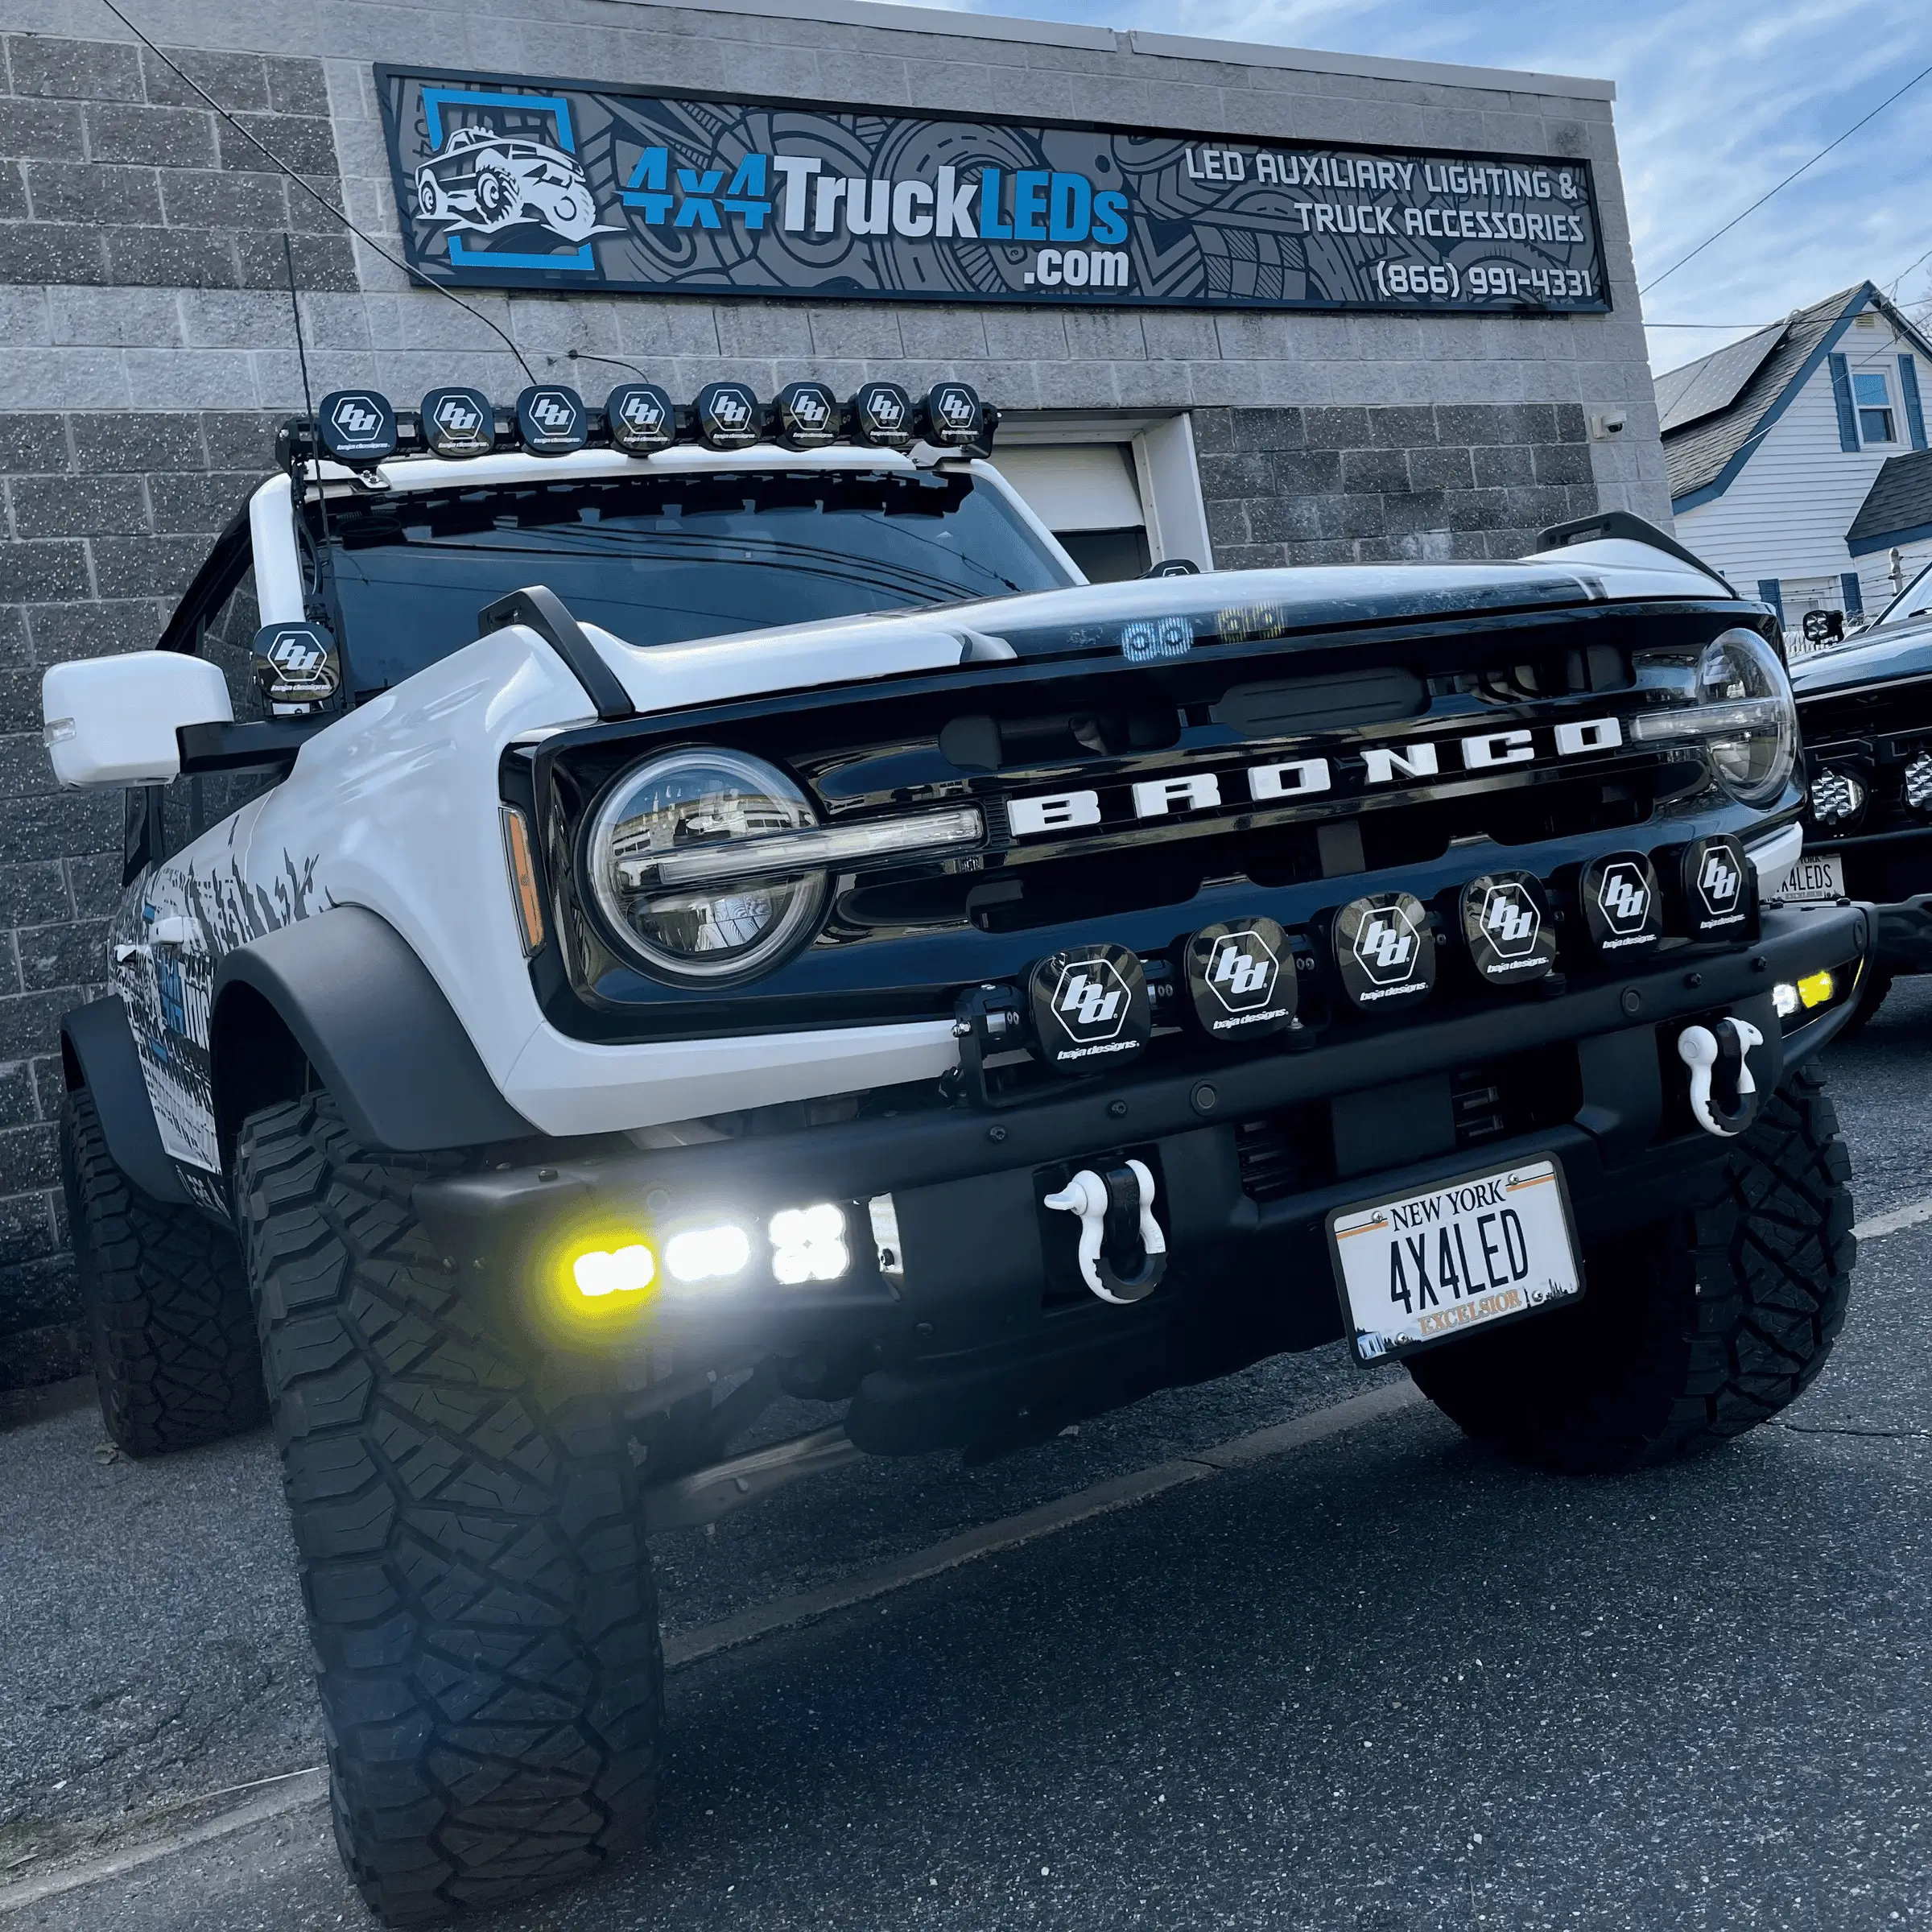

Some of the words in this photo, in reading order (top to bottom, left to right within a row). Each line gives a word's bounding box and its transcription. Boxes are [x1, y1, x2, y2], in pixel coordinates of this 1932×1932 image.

[1185, 148, 1245, 181] LED
[1256, 153, 1419, 192] AUXILIARY
[1425, 165, 1550, 200] LIGHTING
[1558, 173, 1579, 200] &
[1294, 203, 1396, 236] TRUCK
[1405, 208, 1583, 242] ACCESSORIES
[1023, 248, 1128, 287] .com
[1377, 259, 1459, 297] (866)
[1469, 263, 1592, 297] 991-4331
[1006, 717, 1623, 837] BRONCO
[1487, 962, 1510, 973] baja
[1510, 956, 1547, 969] designs
[1360, 990, 1385, 1001] baja
[1385, 981, 1426, 996] designs
[1213, 1018, 1240, 1030] baja
[1241, 1008, 1286, 1025] designs
[1057, 1048, 1086, 1060] baja
[1087, 1040, 1137, 1055] designs
[1390, 1196, 1442, 1232] NEW
[1446, 1179, 1506, 1216] YORK
[1390, 1208, 1529, 1315] 4X4LED
[1418, 1289, 1522, 1335] EXCELSIOR
